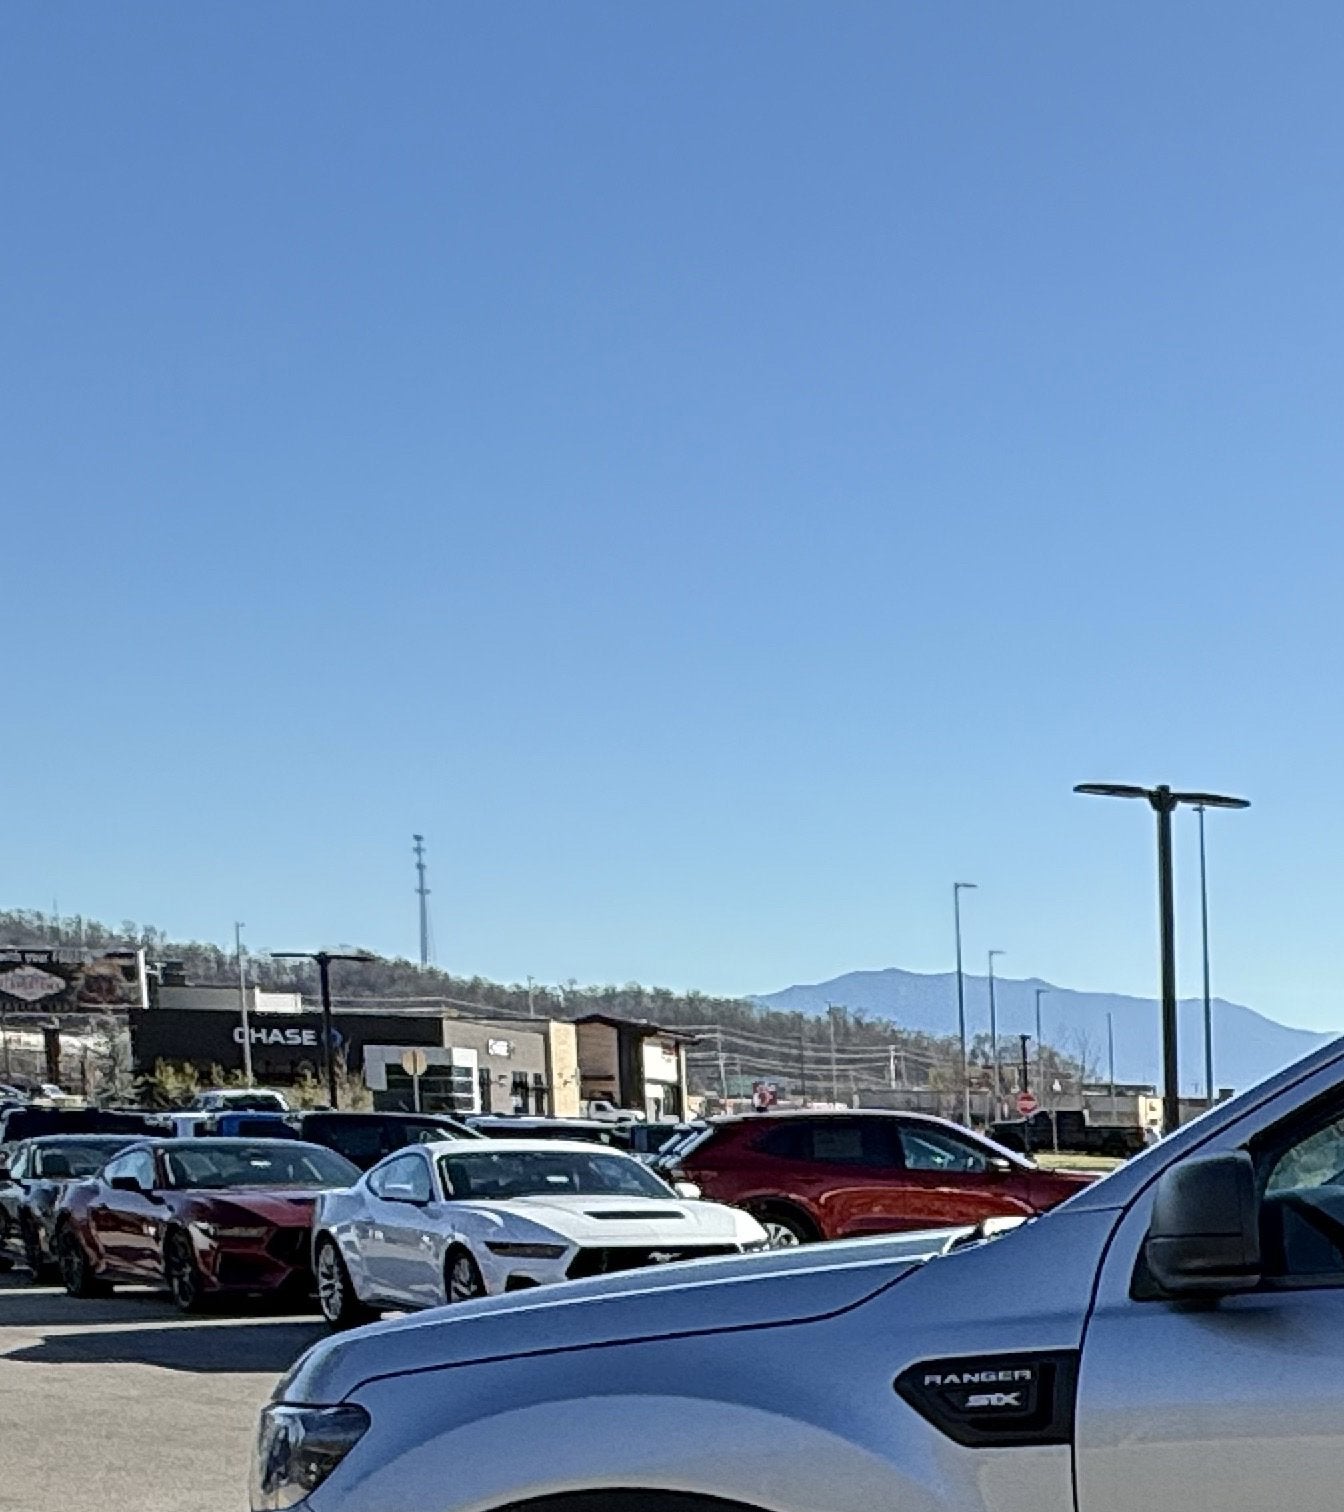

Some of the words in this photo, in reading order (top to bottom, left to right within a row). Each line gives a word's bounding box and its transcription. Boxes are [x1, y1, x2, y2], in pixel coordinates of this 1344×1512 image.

[232, 1026, 319, 1046] CHASE
[924, 1369, 1033, 1386] RANGER
[964, 1391, 1022, 1408] STX
